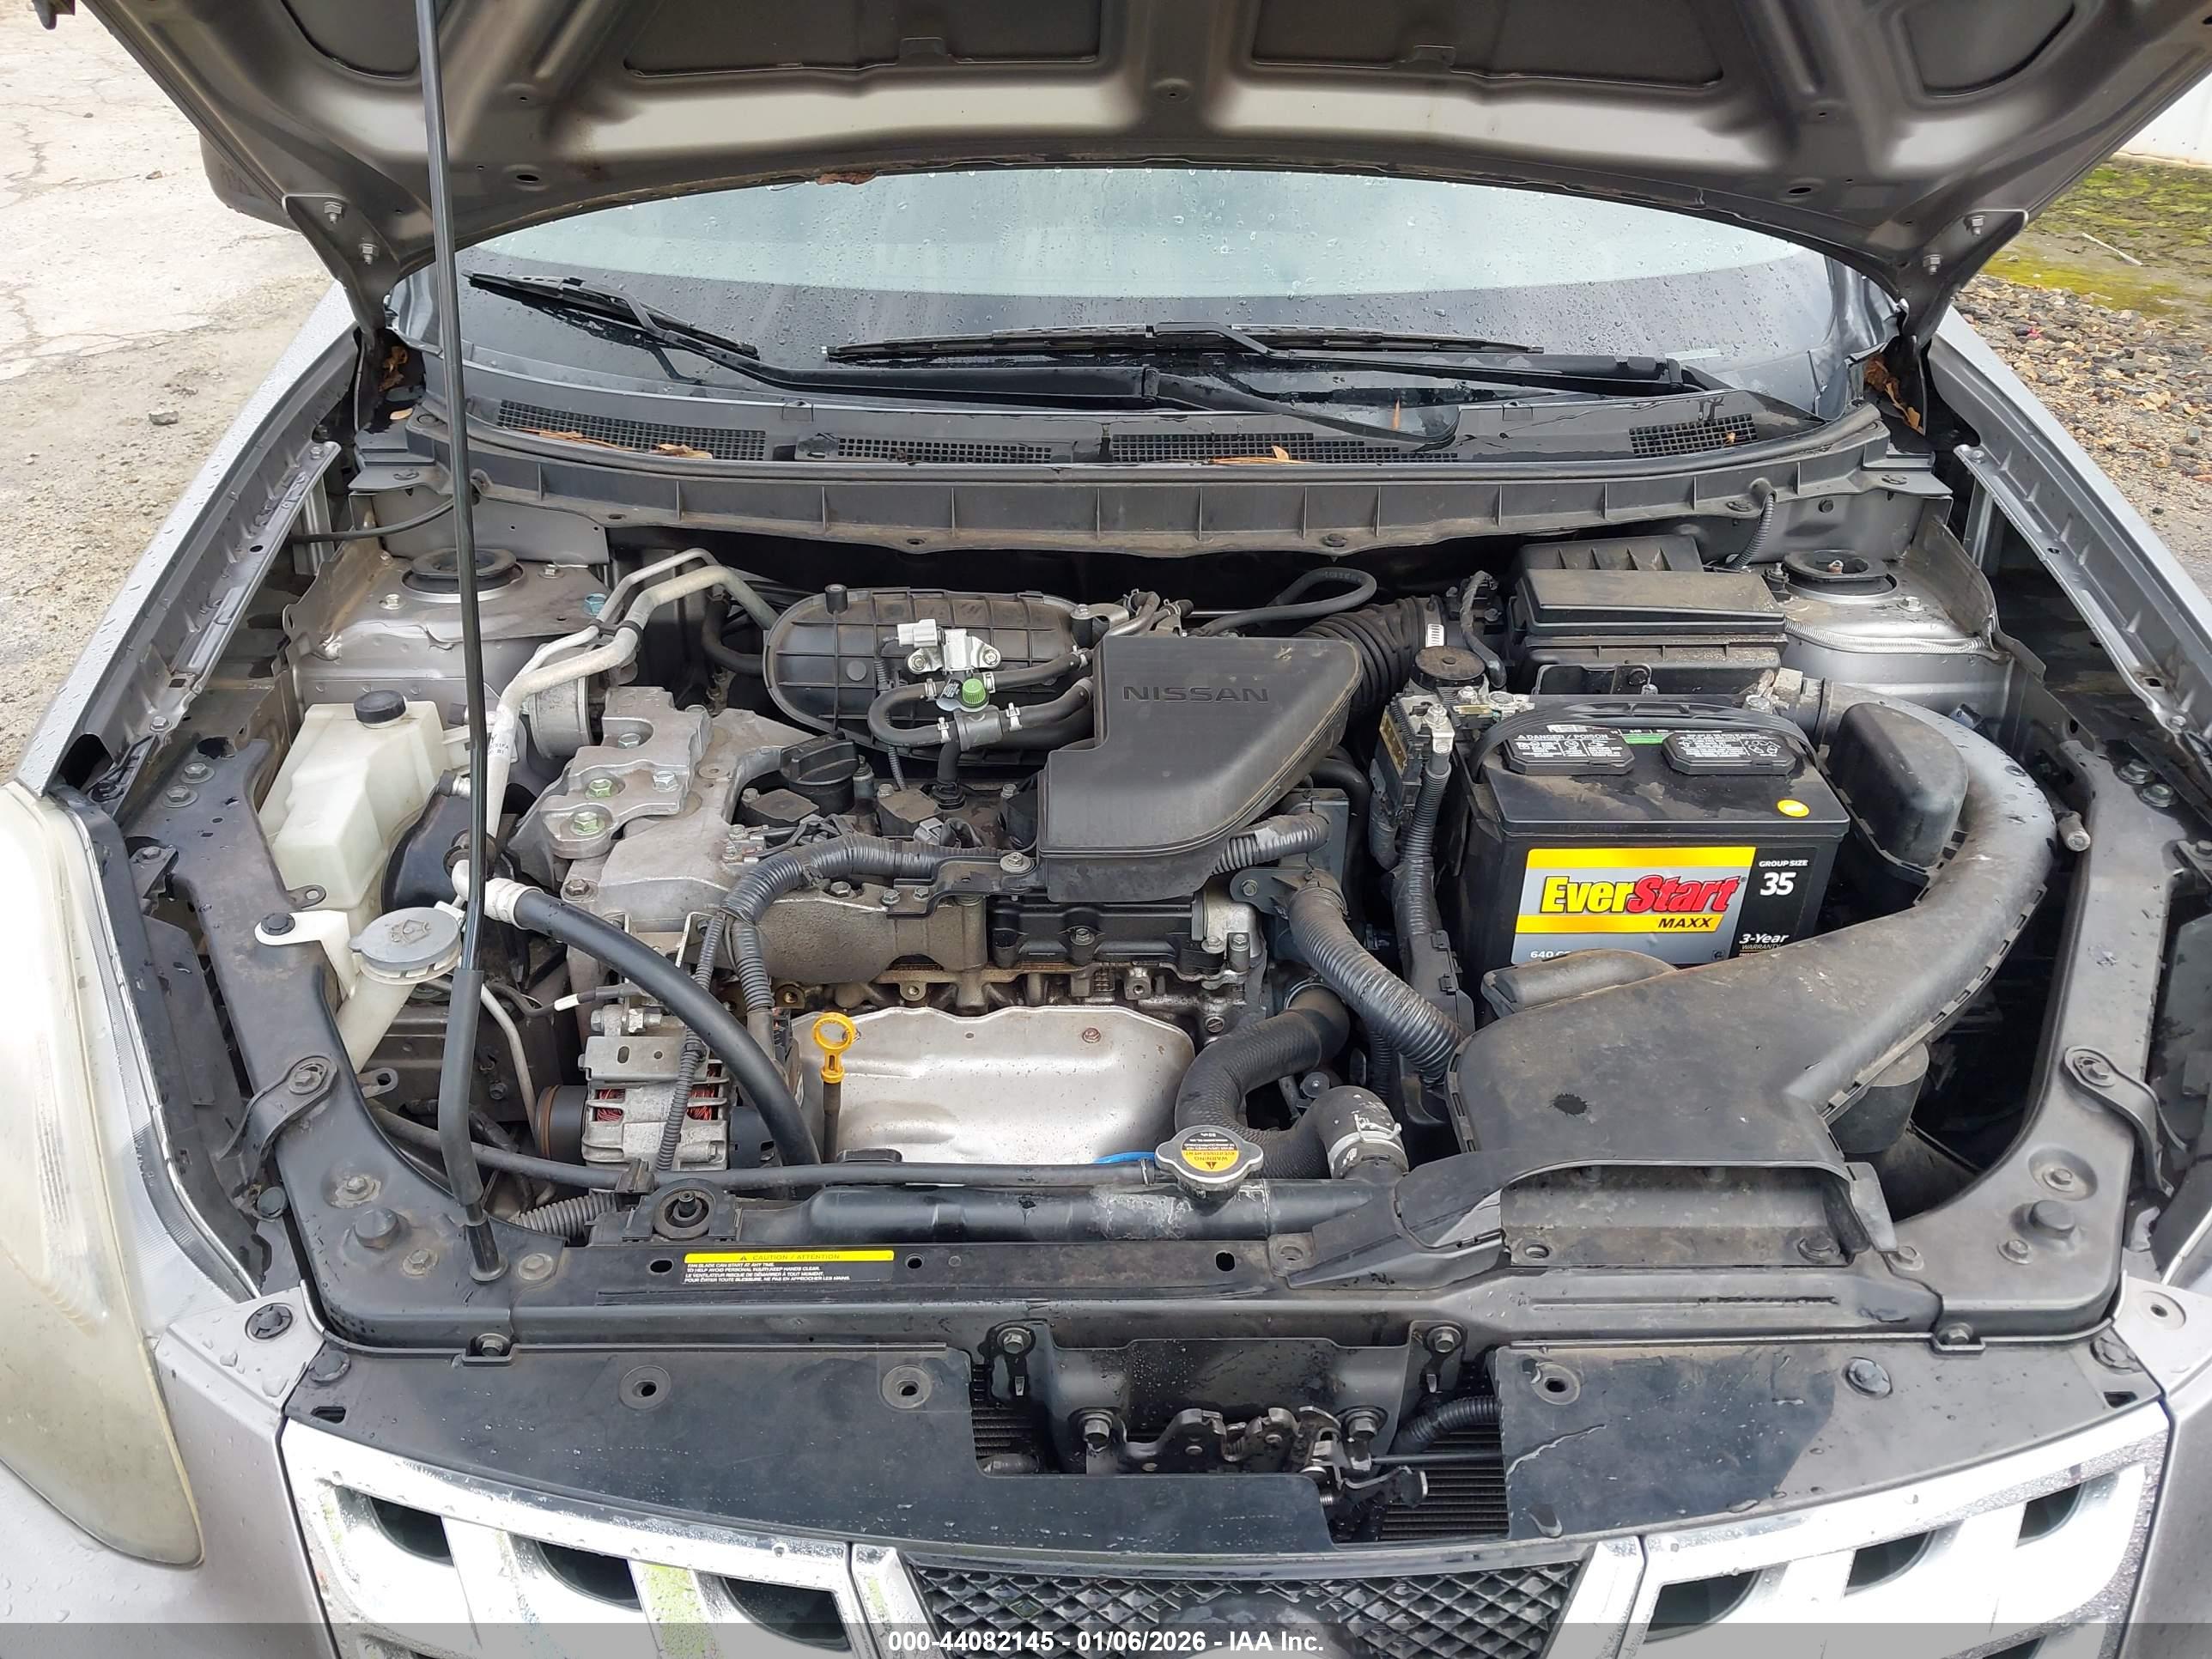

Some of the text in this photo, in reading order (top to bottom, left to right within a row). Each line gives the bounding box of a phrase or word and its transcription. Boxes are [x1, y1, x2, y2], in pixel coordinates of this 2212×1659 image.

[1122, 685, 1269, 702] NISSAN
[1759, 872, 1796, 896] 35
[1540, 875, 1741, 914] EverStart
[1657, 917, 1713, 928] MAXX
[1739, 933, 1790, 944] 3-Year
